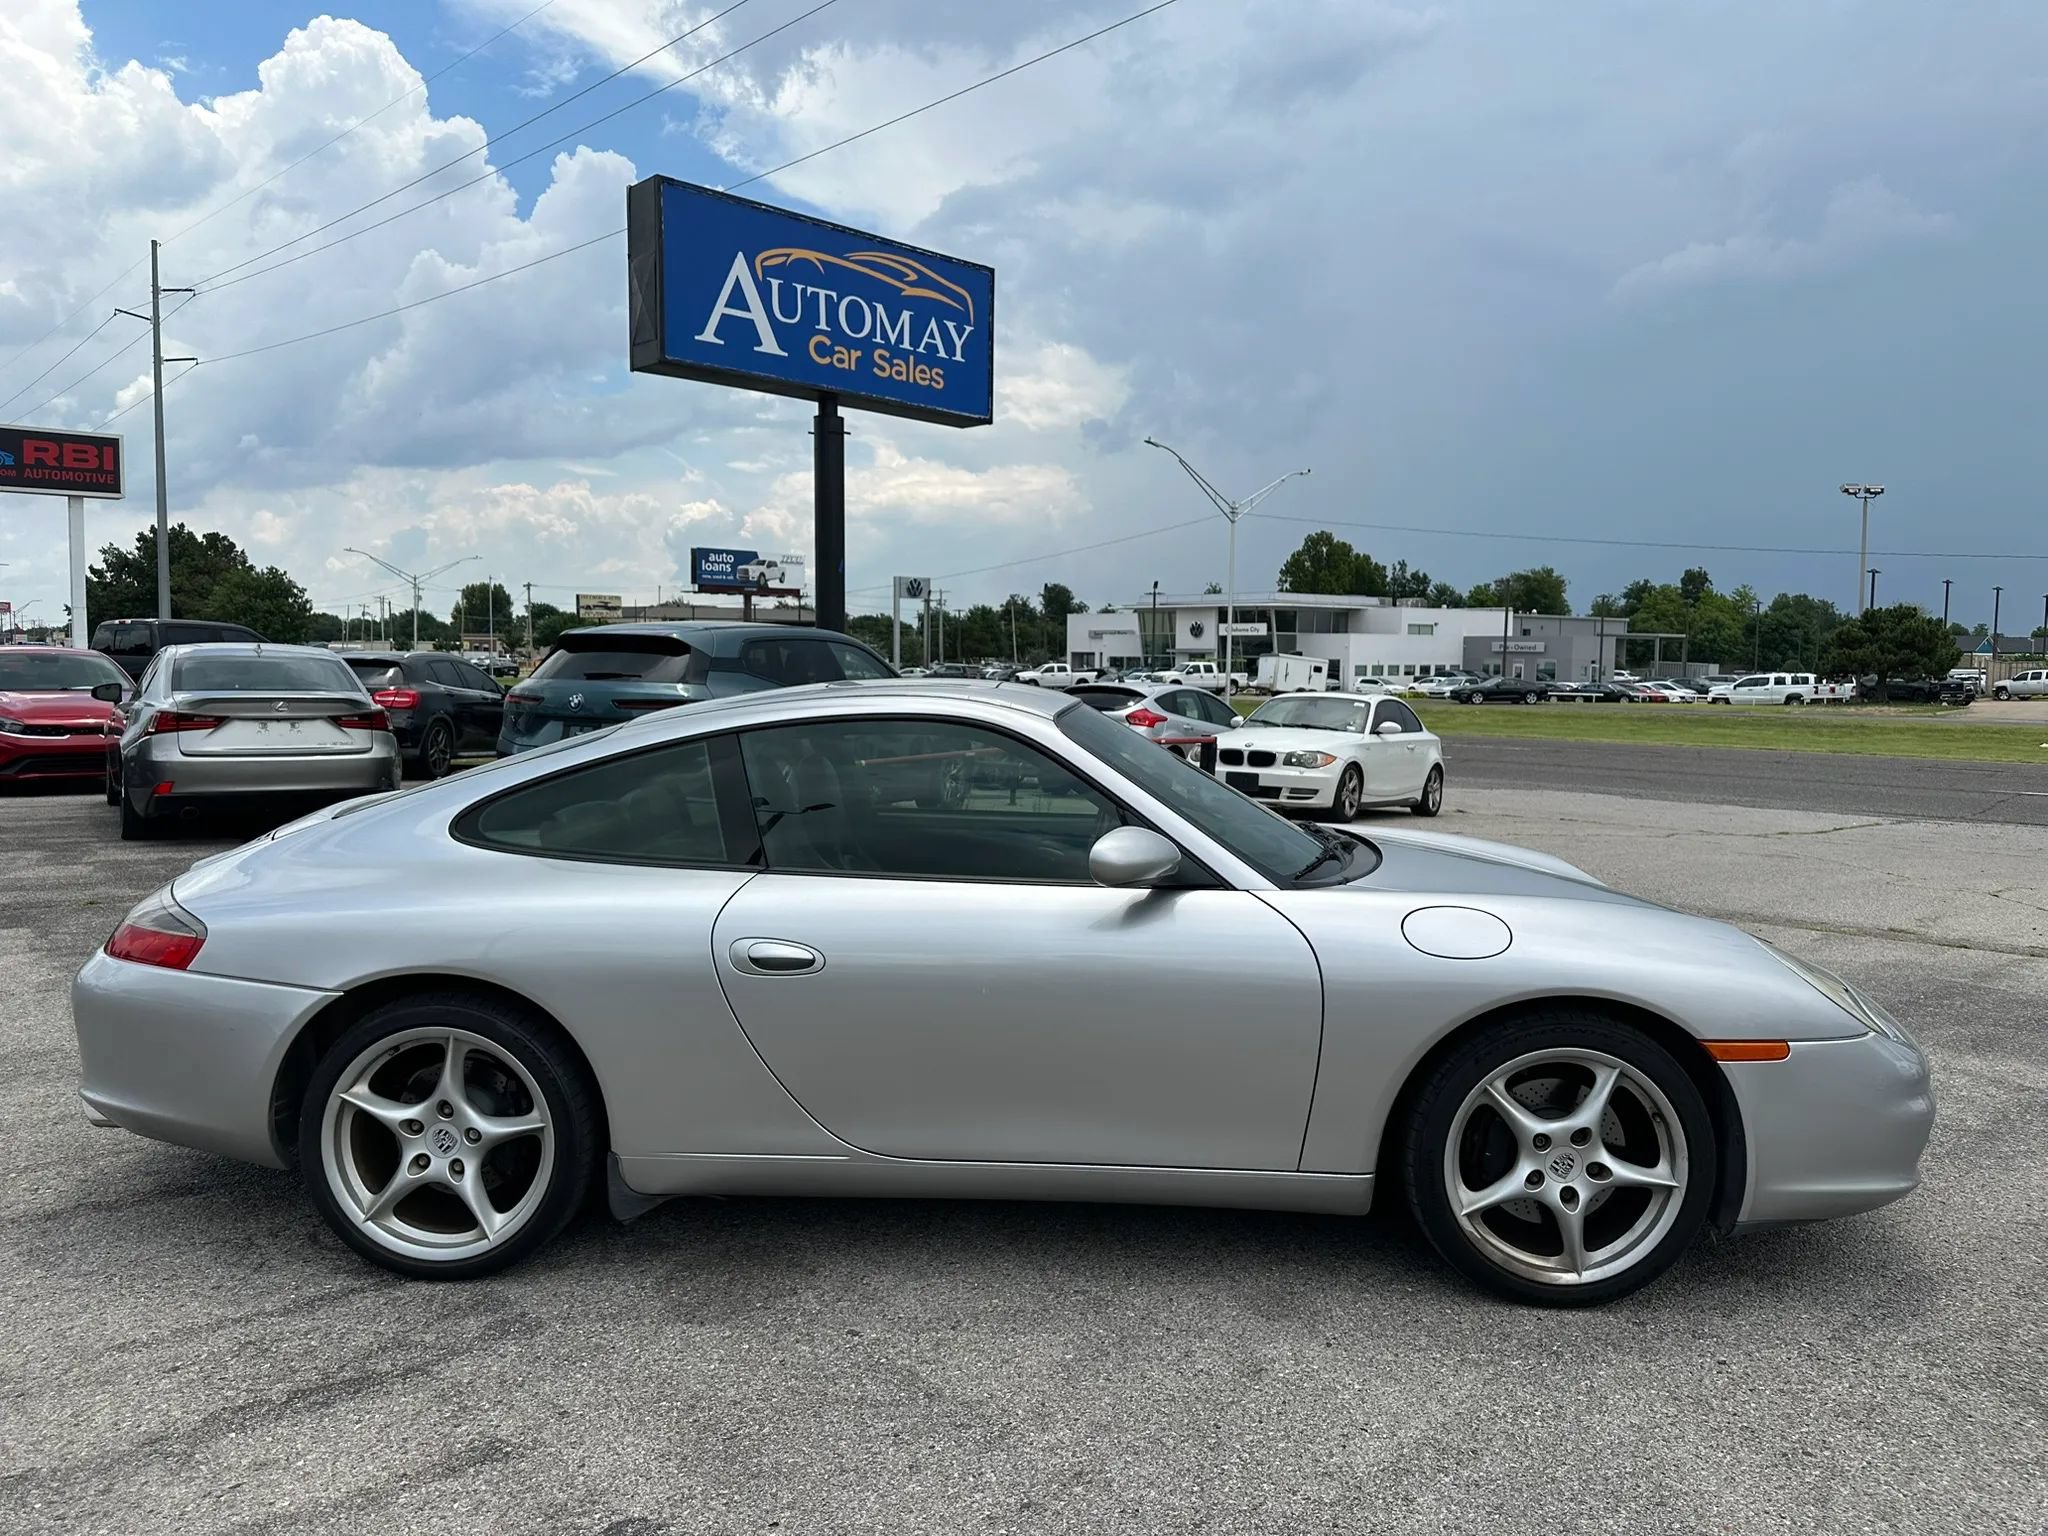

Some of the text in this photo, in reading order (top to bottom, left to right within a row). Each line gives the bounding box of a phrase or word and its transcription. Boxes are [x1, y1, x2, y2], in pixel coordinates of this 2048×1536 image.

[695, 250, 975, 362] AUTOMAY
[809, 334, 944, 390] Car Sales
[23, 439, 114, 471] RBI
[24, 467, 115, 485] AUTOMOTIVE
[702, 559, 732, 572] loans
[709, 552, 734, 563] auto
